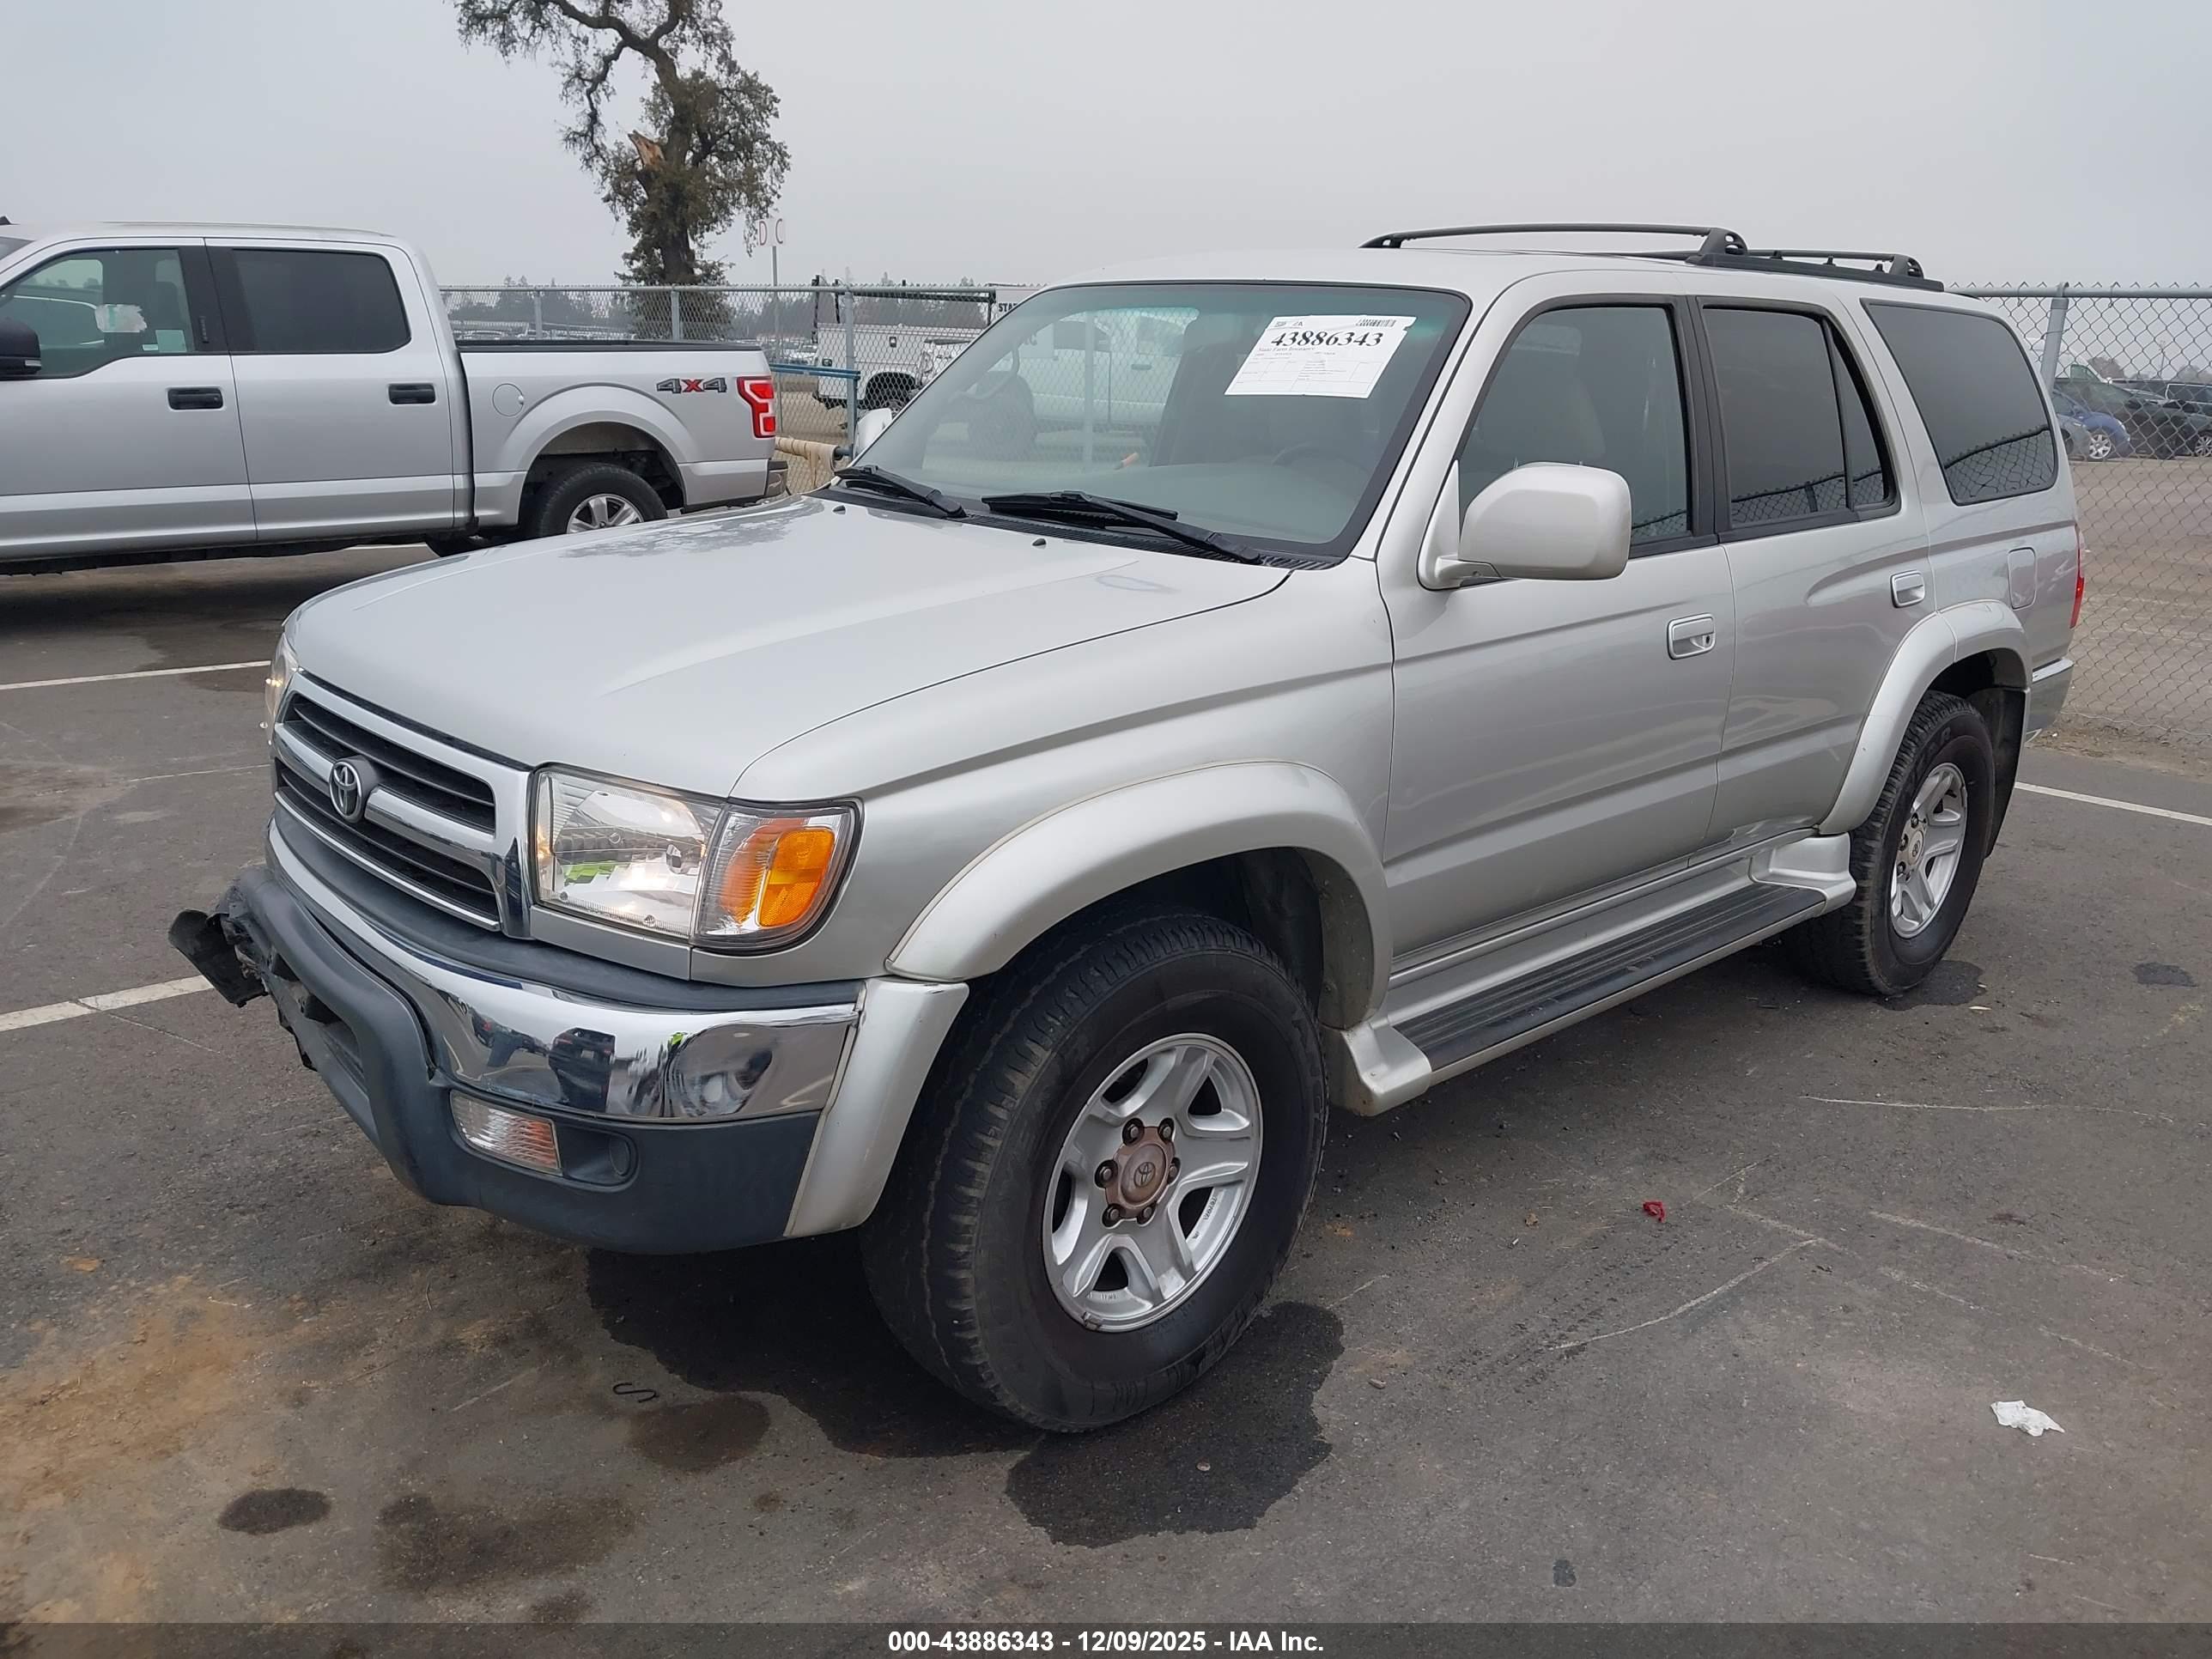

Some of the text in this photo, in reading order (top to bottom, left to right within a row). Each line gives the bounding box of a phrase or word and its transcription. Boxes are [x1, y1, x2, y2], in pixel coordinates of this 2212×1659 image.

[758, 220, 768, 246] D
[775, 217, 784, 245] C
[998, 302, 1018, 313] STA
[1271, 330, 1383, 347] 43886343
